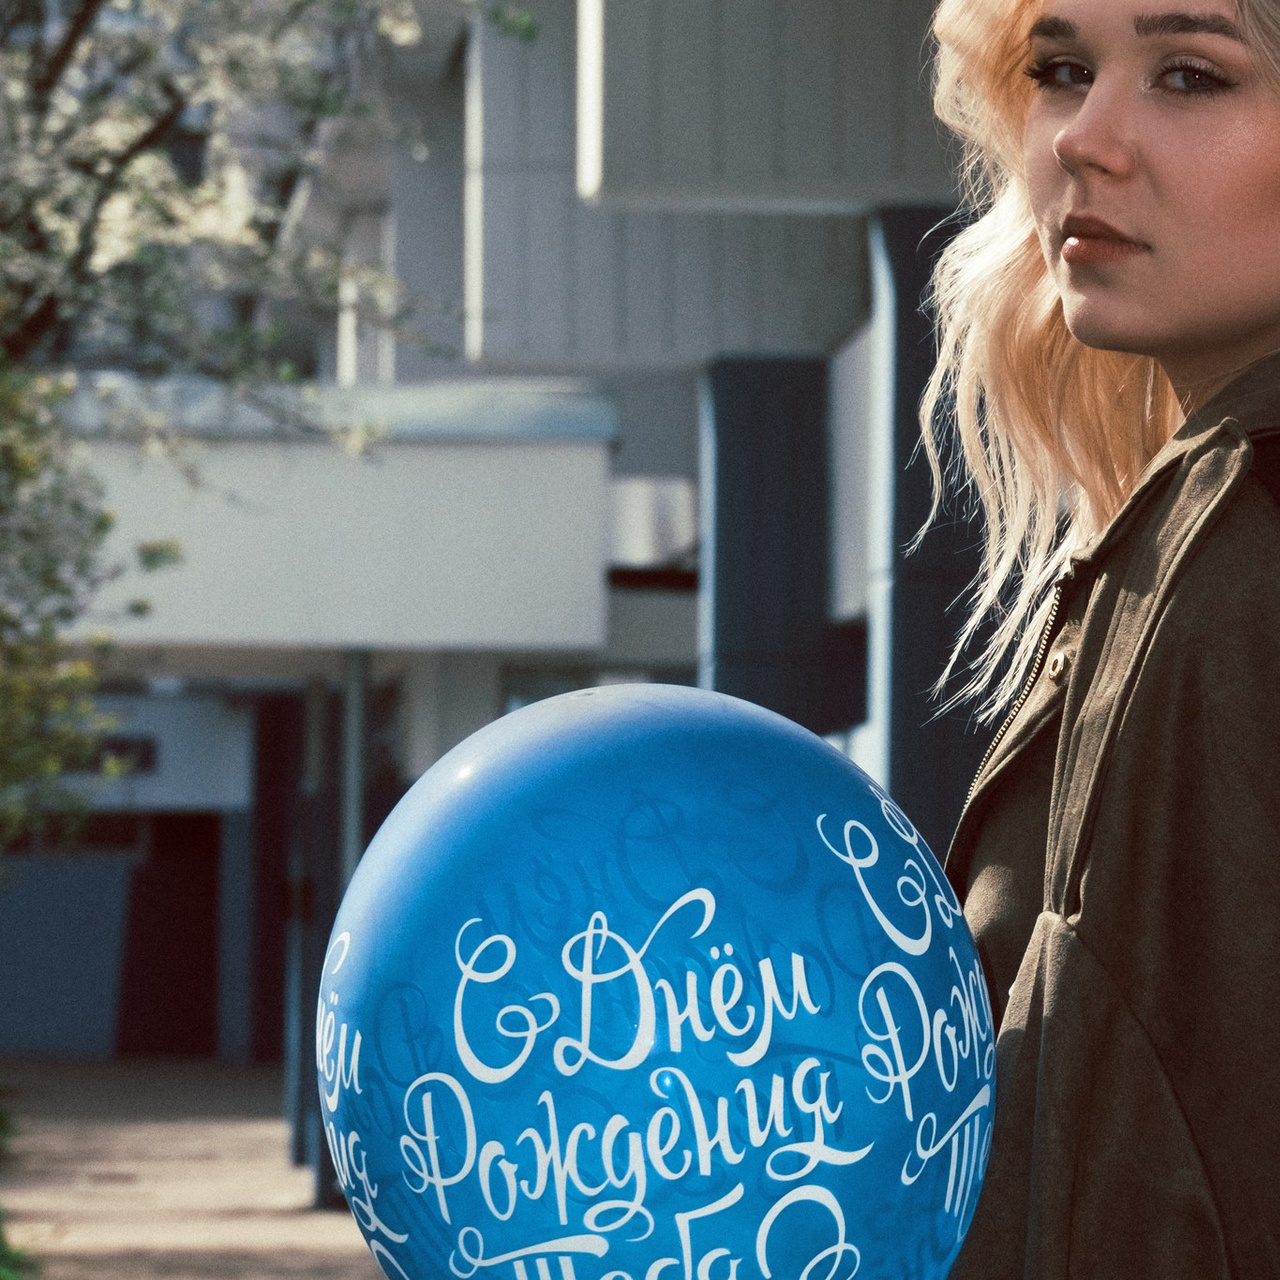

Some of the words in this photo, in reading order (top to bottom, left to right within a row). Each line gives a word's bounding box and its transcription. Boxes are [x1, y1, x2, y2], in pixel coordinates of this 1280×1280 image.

[454, 918, 560, 1083] С
[553, 888, 821, 1076] Днём
[400, 1057, 875, 1242] Рождения
